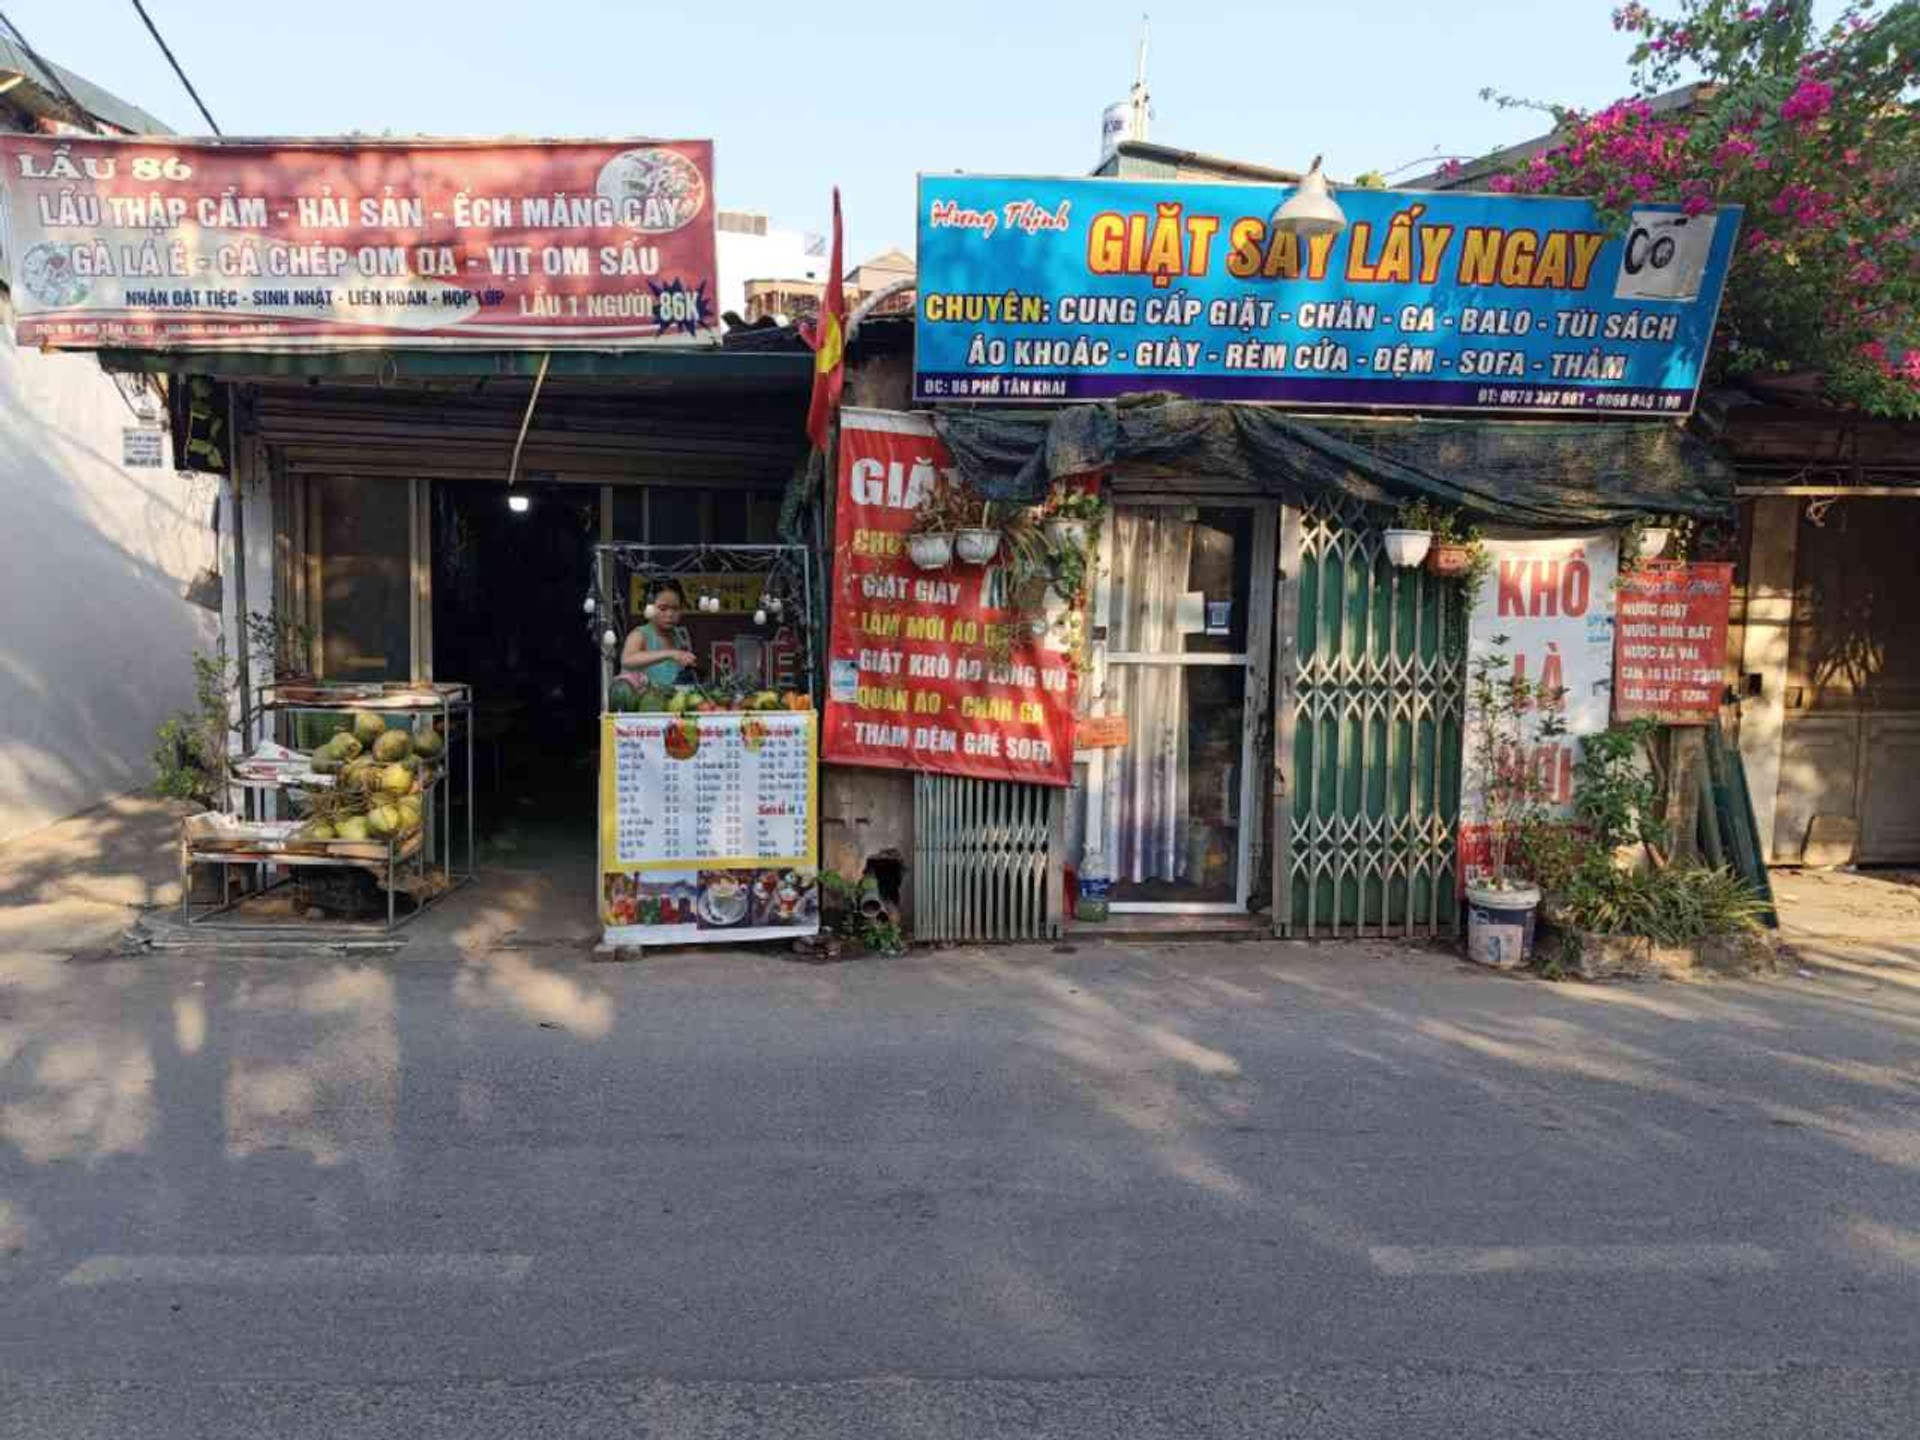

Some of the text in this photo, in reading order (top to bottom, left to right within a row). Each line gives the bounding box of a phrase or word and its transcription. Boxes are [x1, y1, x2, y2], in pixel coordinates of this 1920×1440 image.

[132, 156, 193, 181] 86
[108, 191, 188, 236] THẬP
[197, 185, 268, 229] CẨM
[297, 185, 349, 228] HẢI
[359, 185, 422, 229] SẢN
[453, 184, 512, 228] ẾCH
[522, 192, 613, 228] MĂNG
[624, 198, 680, 228] CAY
[71, 239, 116, 277] GÀ
[121, 239, 163, 277] LÁ
[218, 240, 261, 277] CÁ
[269, 240, 348, 277] CHÉP
[357, 245, 408, 277] OM
[487, 246, 532, 282] VỊT
[542, 246, 590, 276] OM
[600, 236, 660, 276] SẤU
[1088, 202, 1219, 288] GIẶT
[1345, 202, 1456, 286] LẤY
[1457, 224, 1603, 291] NGAY
[126, 288, 168, 308] NHẬN
[205, 288, 238, 309] TIỆC
[252, 289, 290, 307] SINH
[293, 288, 333, 310] NHẬT
[348, 287, 381, 306] LIÊN
[386, 289, 428, 306] HOAN
[442, 290, 472, 309] HỌP
[568, 295, 578, 317] 1
[587, 289, 653, 317] NGƯỜI
[659, 291, 700, 321] 86K
[925, 289, 1050, 323] CHUYÊN:
[1058, 296, 1137, 325] CUNG
[1145, 288, 1201, 326] CẤP
[1209, 293, 1274, 333] GIẶT
[1298, 298, 1376, 331] CHĂN
[1400, 305, 1436, 332] GA
[1459, 307, 1532, 336] BALO
[1556, 308, 1599, 338] TÚI
[1604, 308, 1678, 341] SÁCH
[966, 334, 1007, 367] ÁO
[1013, 334, 1110, 368] KHOÁC
[1134, 335, 1201, 368] GIÀY
[1373, 343, 1436, 380] ĐỆM
[1458, 350, 1526, 377] SOFA
[1550, 347, 1628, 381] THẢM
[971, 375, 1000, 395] PHỐ
[1003, 376, 1030, 396] TÂN
[1497, 547, 1591, 619] KHÔ
[908, 650, 950, 680] KHÔ
